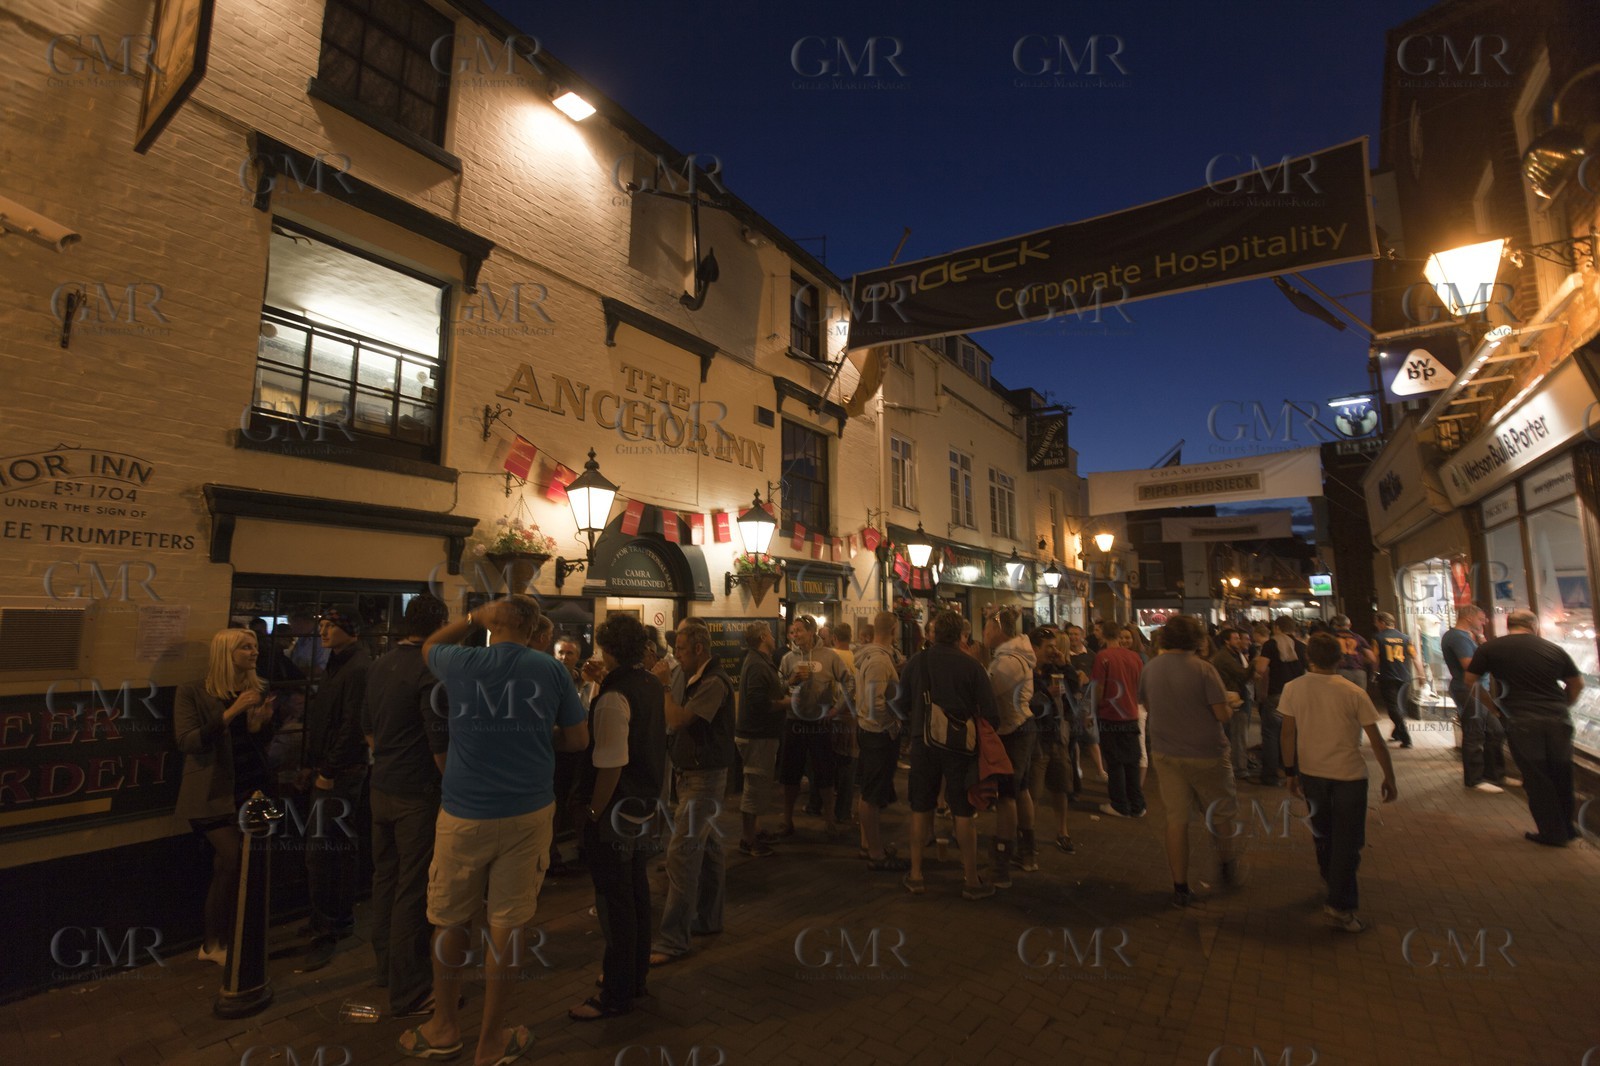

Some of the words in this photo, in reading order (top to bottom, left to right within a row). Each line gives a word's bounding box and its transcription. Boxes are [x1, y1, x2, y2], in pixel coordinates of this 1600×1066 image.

[995, 262, 1141, 310] Corporate
[1154, 222, 1348, 279] Hospitality
[620, 361, 691, 412] THE
[496, 363, 709, 456] ANCHOR
[714, 430, 765, 472] INN
[1509, 415, 1550, 453] Porter
[0, 455, 70, 486] OR
[90, 455, 154, 484] INN
[1151, 461, 1244, 478] CHAMPAGNE
[90, 485, 137, 502] 1704
[1143, 476, 1254, 498] PIPER-HEIDSIECK
[5, 498, 57, 510] UNDER
[64, 503, 90, 514] THE
[96, 506, 126, 517] SIGN
[130, 510, 147, 518] OF
[41, 524, 195, 550] TRUMPETERS
[611, 577, 666, 588] RECOMMENDED
[625, 569, 651, 578] CAMRA
[708, 622, 723, 632] THE
